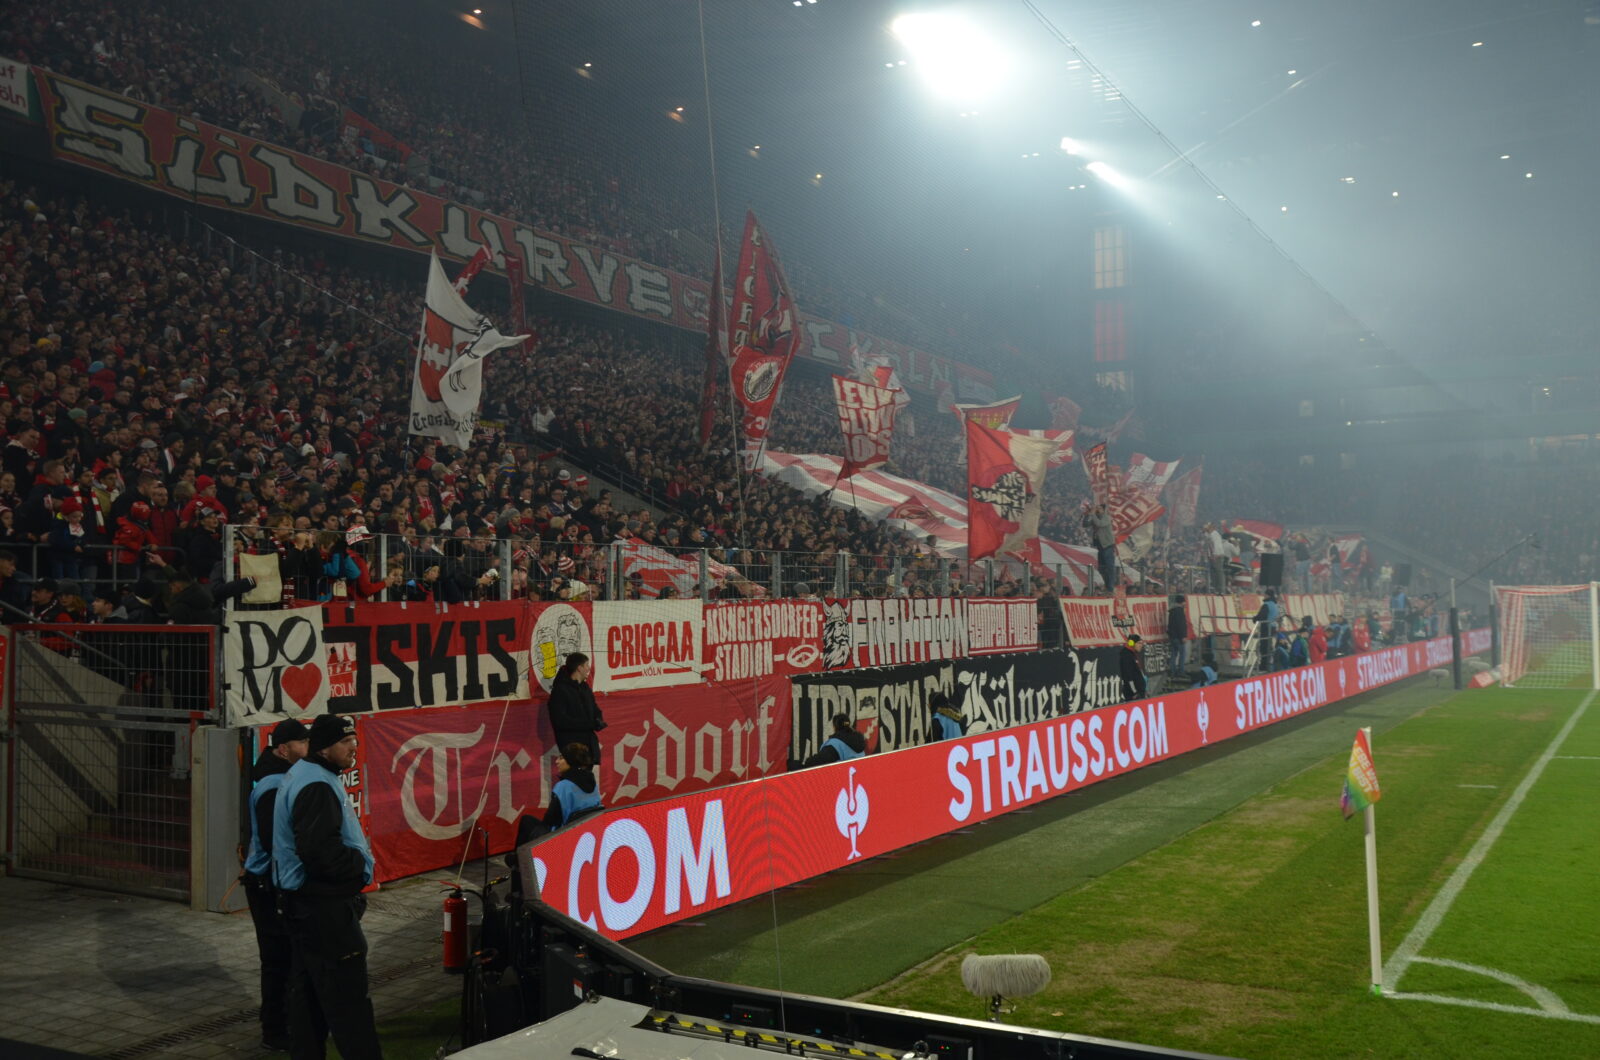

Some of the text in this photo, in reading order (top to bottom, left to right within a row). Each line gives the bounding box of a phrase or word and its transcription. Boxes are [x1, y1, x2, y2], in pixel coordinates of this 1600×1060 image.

[54, 77, 673, 320] SÜDKURVE
[607, 620, 694, 669] CRICCAA
[715, 641, 774, 682] STADION
[852, 598, 969, 668] FRAKTION
[957, 664, 1063, 736] Kölner
[1235, 666, 1327, 730] STRAUSS.COM
[391, 695, 776, 840] Trsdorf
[947, 701, 1169, 822] STRAUSS.COM
[533, 799, 731, 932] COM
